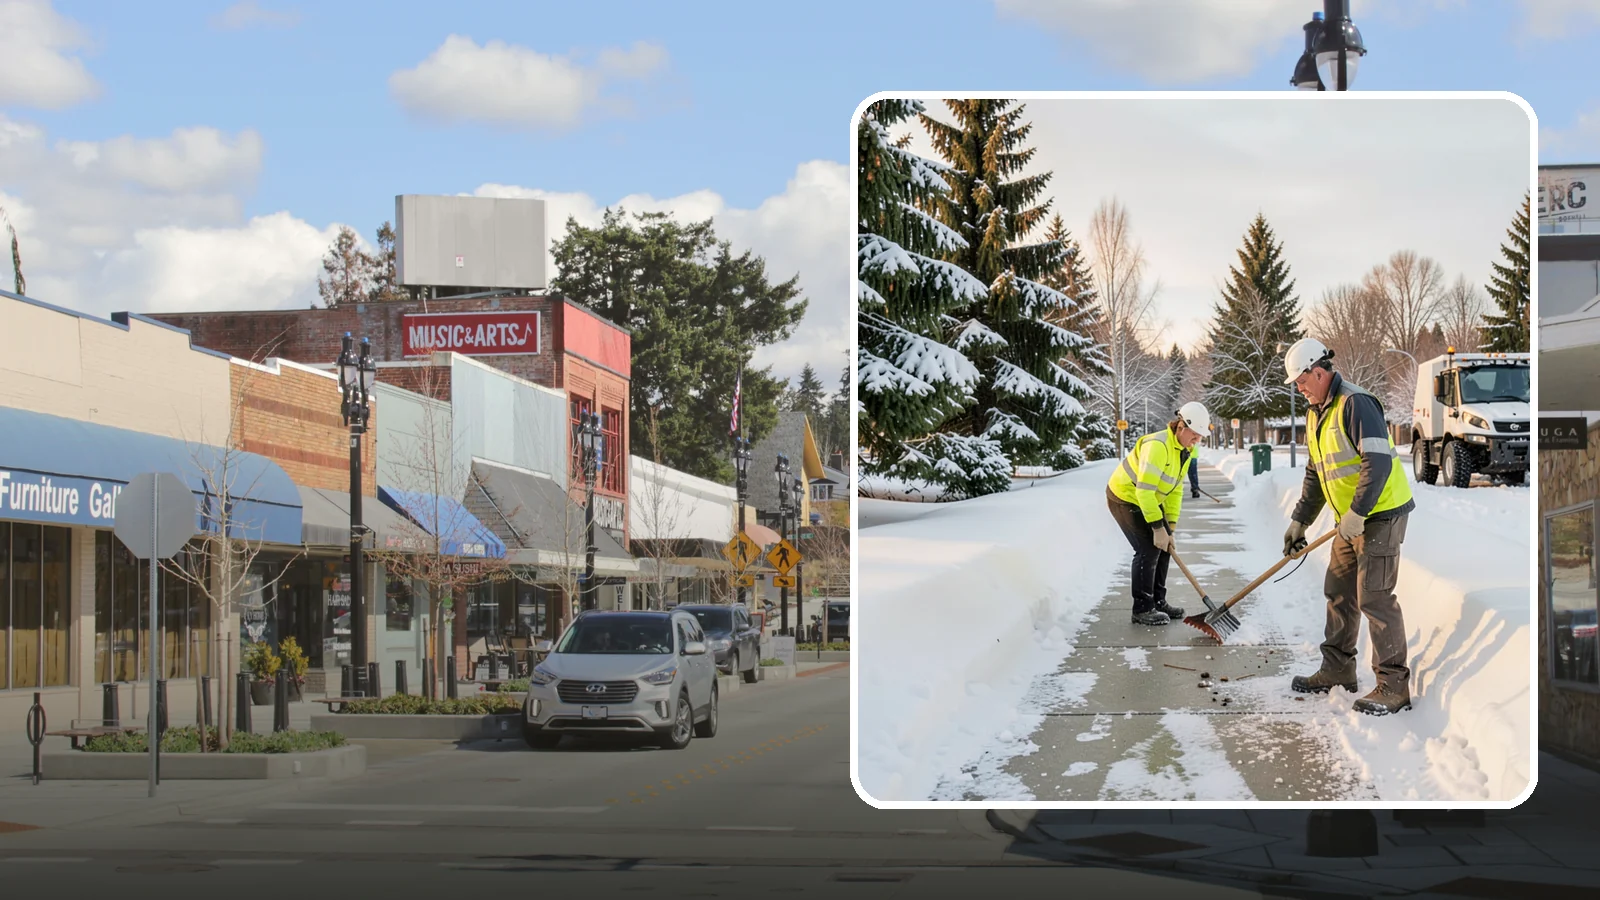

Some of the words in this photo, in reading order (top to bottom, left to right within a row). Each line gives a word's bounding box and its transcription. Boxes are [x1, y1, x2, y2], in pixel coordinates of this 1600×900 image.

[409, 322, 520, 349] MUSIC&ARTS
[1540, 427, 1577, 436] UGA
[0, 472, 79, 515] Furniture
[89, 483, 121, 518] Gal
